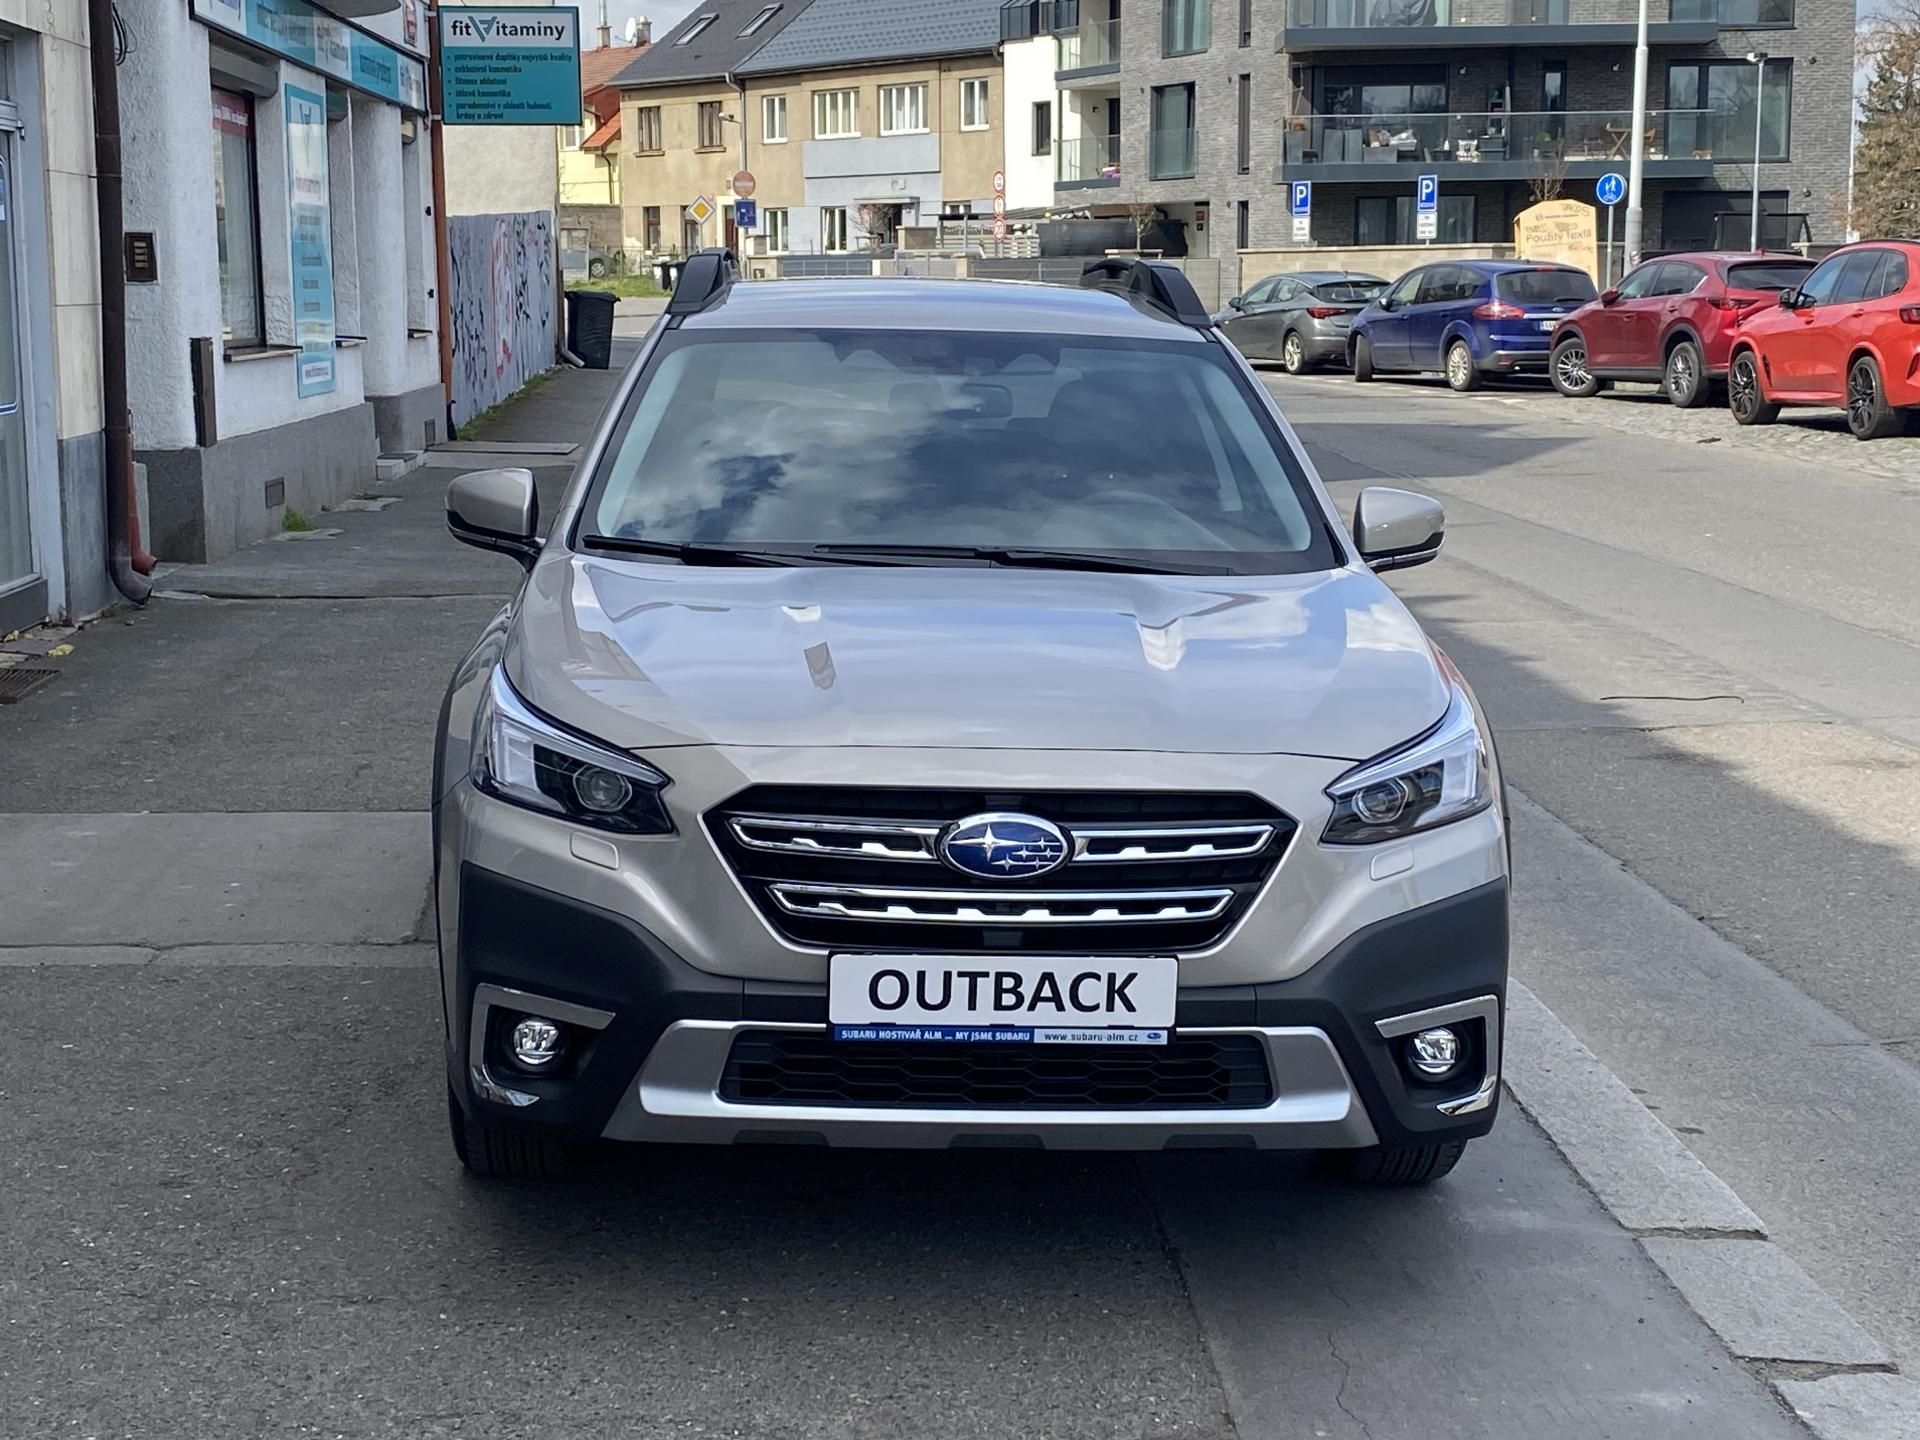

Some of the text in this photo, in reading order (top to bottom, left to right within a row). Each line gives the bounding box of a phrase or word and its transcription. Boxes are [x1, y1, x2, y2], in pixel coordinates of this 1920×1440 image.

[1296, 186, 1307, 205] P
[1422, 180, 1433, 200] P
[868, 969, 1138, 1012] OUTBACK
[841, 1030, 876, 1039] SUBARU
[879, 1028, 921, 1040] HOSTIVAŘ
[923, 1031, 942, 1040] ALM
[955, 1031, 970, 1041] MY
[971, 1031, 993, 1042] JSME
[995, 1032, 1030, 1041] SUBARU
[1044, 1033, 1138, 1042] www.subaru-alm.cz
